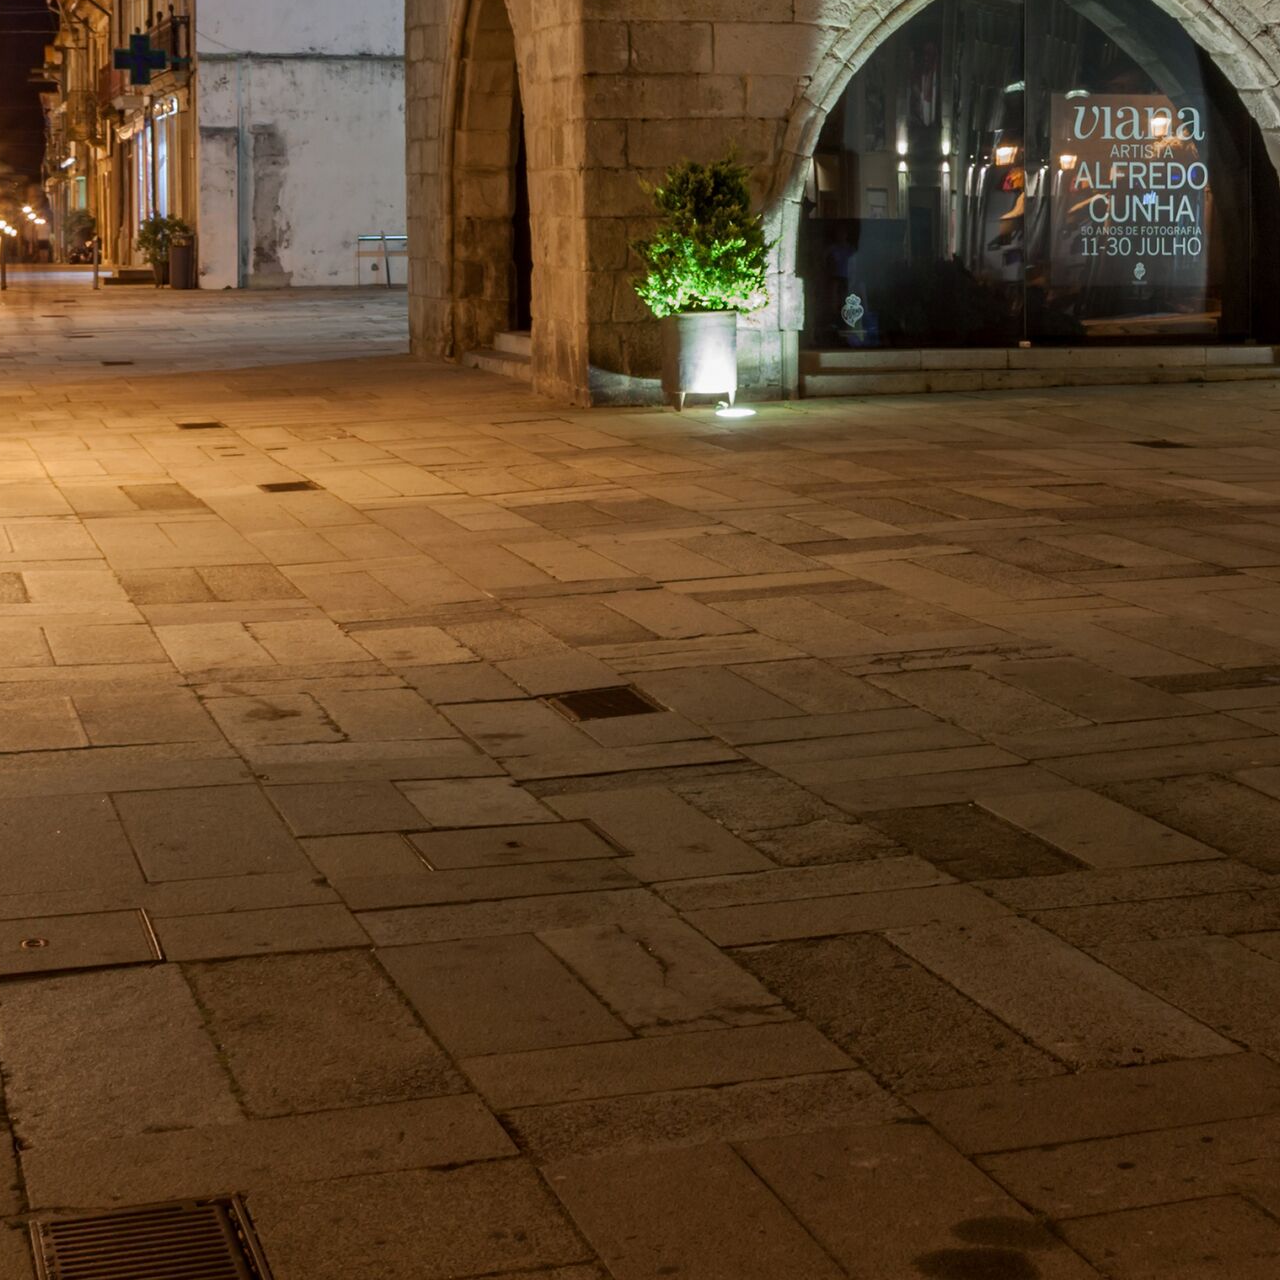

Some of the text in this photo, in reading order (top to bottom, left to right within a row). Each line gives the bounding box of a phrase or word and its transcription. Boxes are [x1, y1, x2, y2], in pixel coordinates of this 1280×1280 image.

[1073, 105, 1205, 141] viana
[1110, 144, 1173, 159] ARTISTA
[1074, 161, 1208, 190] ALFREDO
[1089, 194, 1195, 223] CUNHA
[1080, 226, 1202, 236] 50 ANOS DE FOTOGRAFIA
[1081, 237, 1202, 256] 11-30 JULHO
